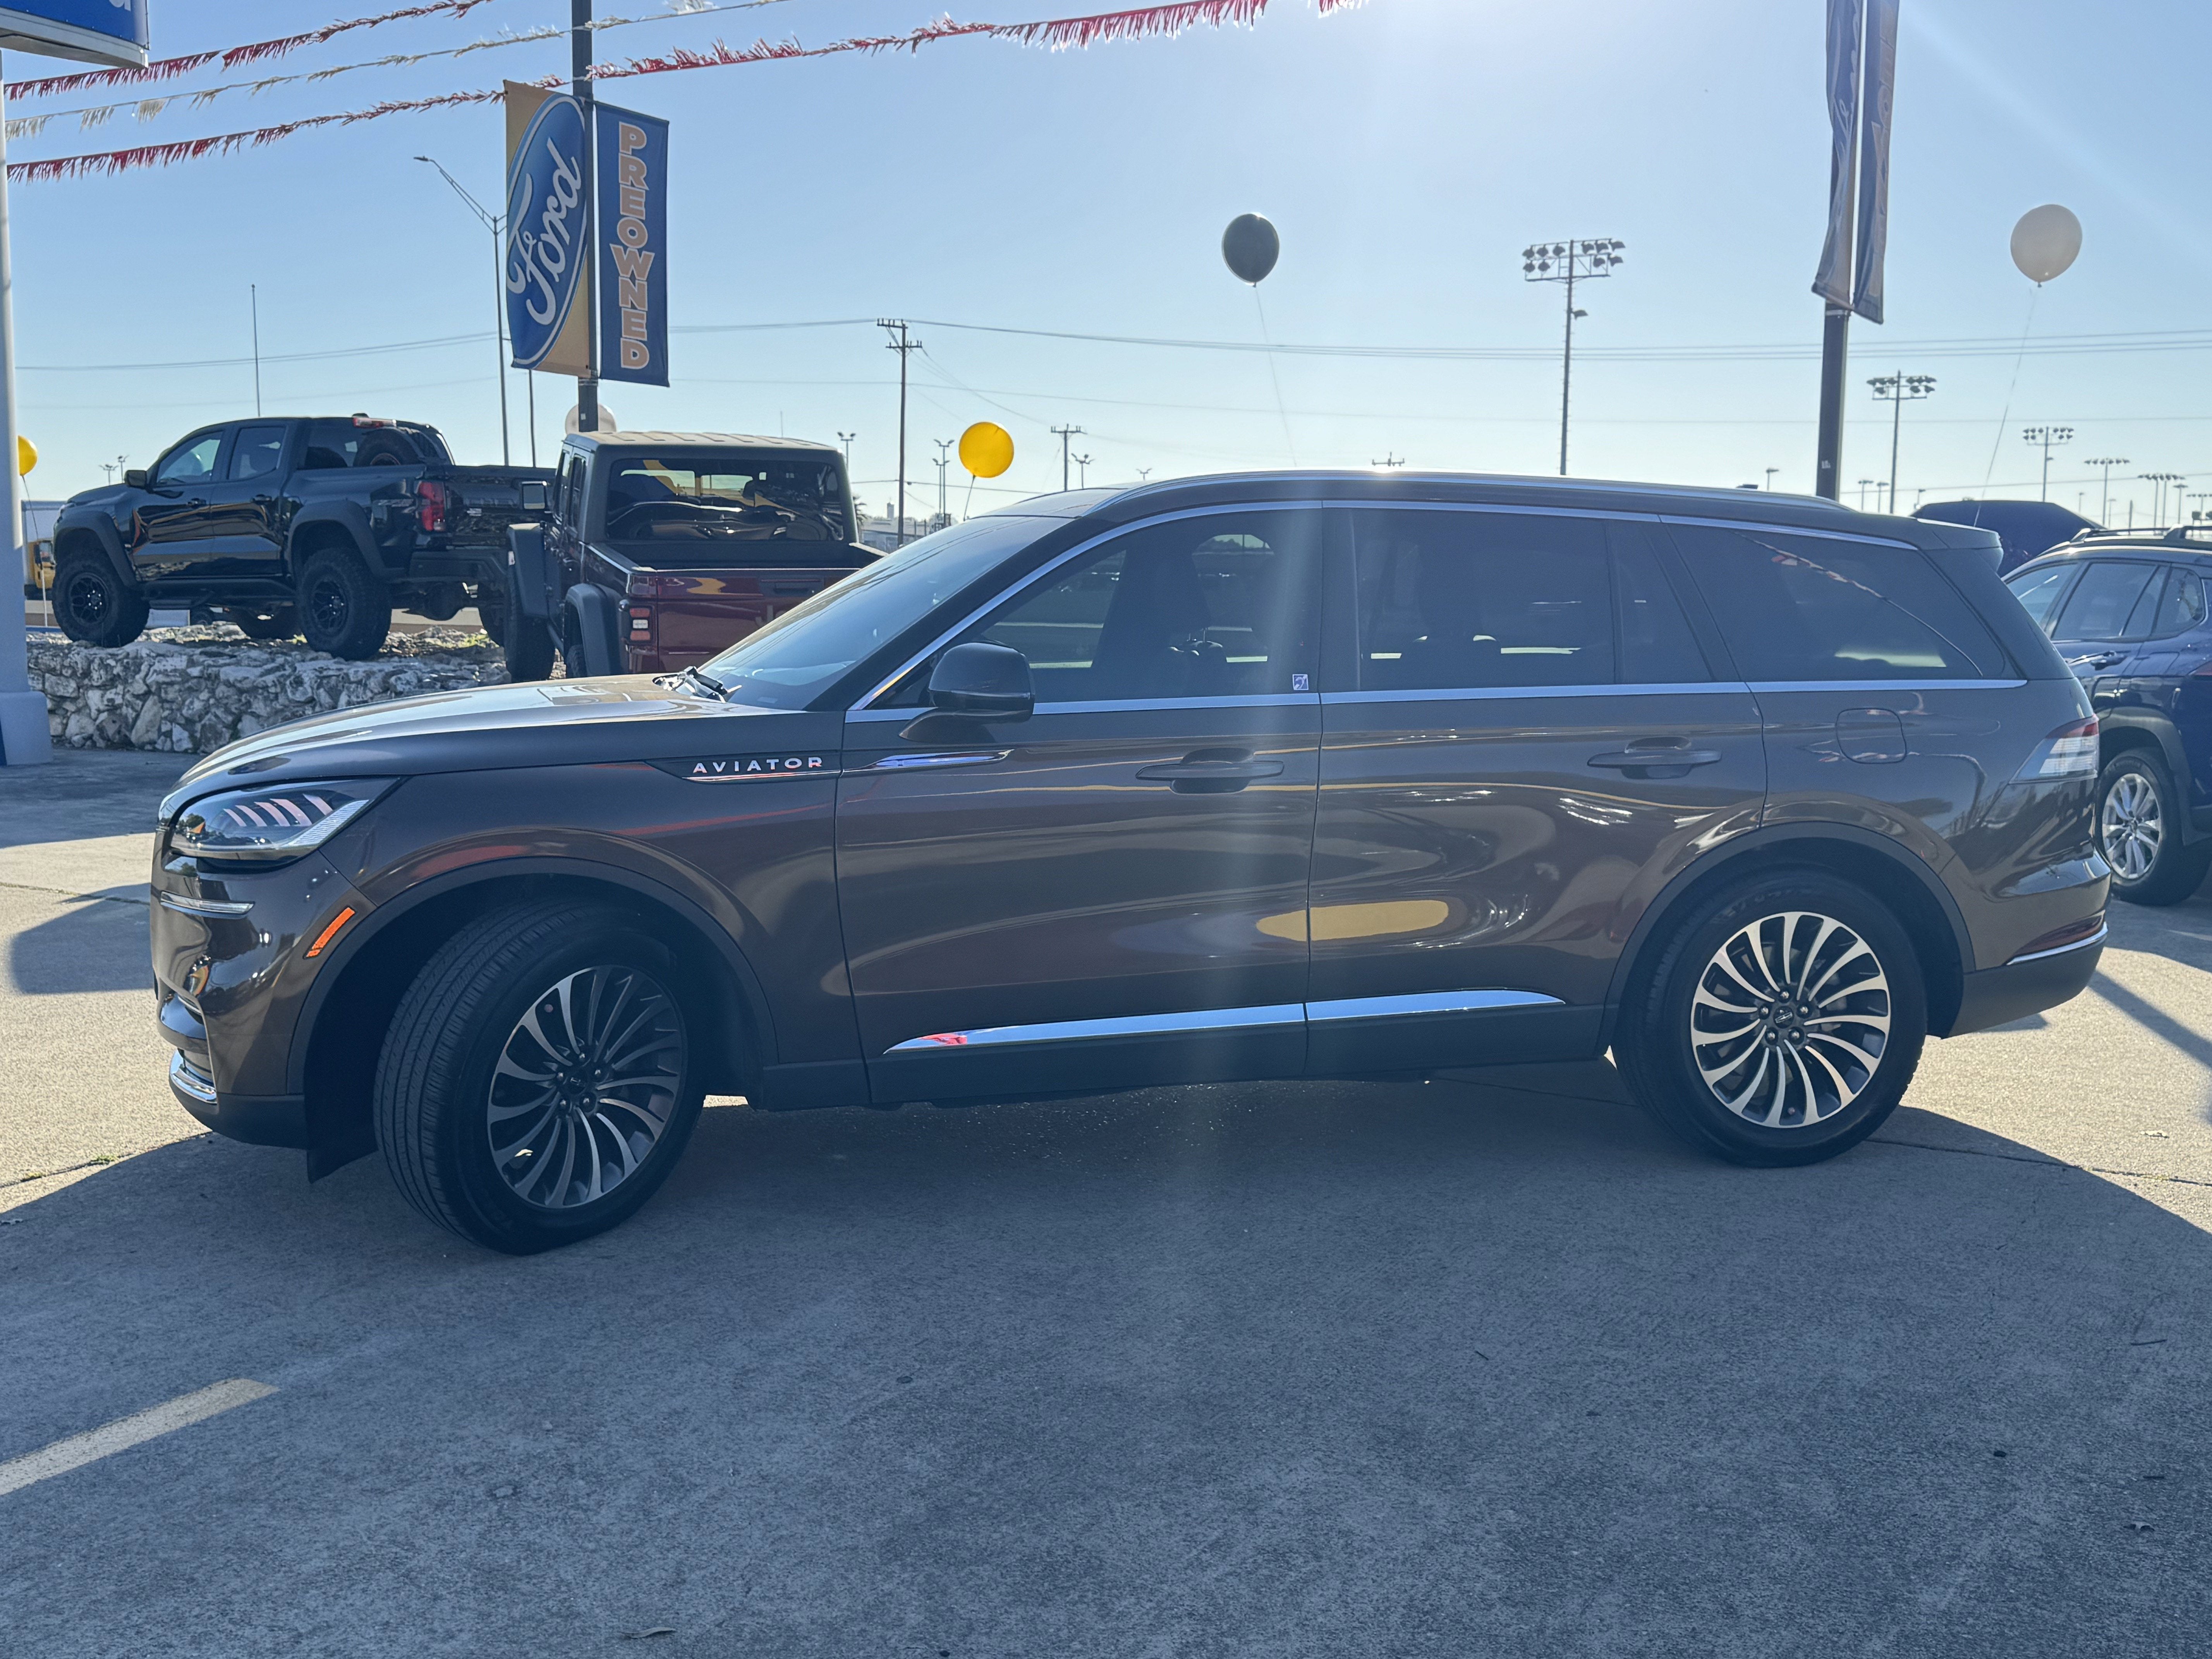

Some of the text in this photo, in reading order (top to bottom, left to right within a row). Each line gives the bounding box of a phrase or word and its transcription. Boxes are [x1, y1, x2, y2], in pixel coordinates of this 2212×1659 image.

[507, 136, 582, 325] Ford
[610, 121, 655, 370] PREOWNED
[693, 757, 823, 773] AVIATOR
